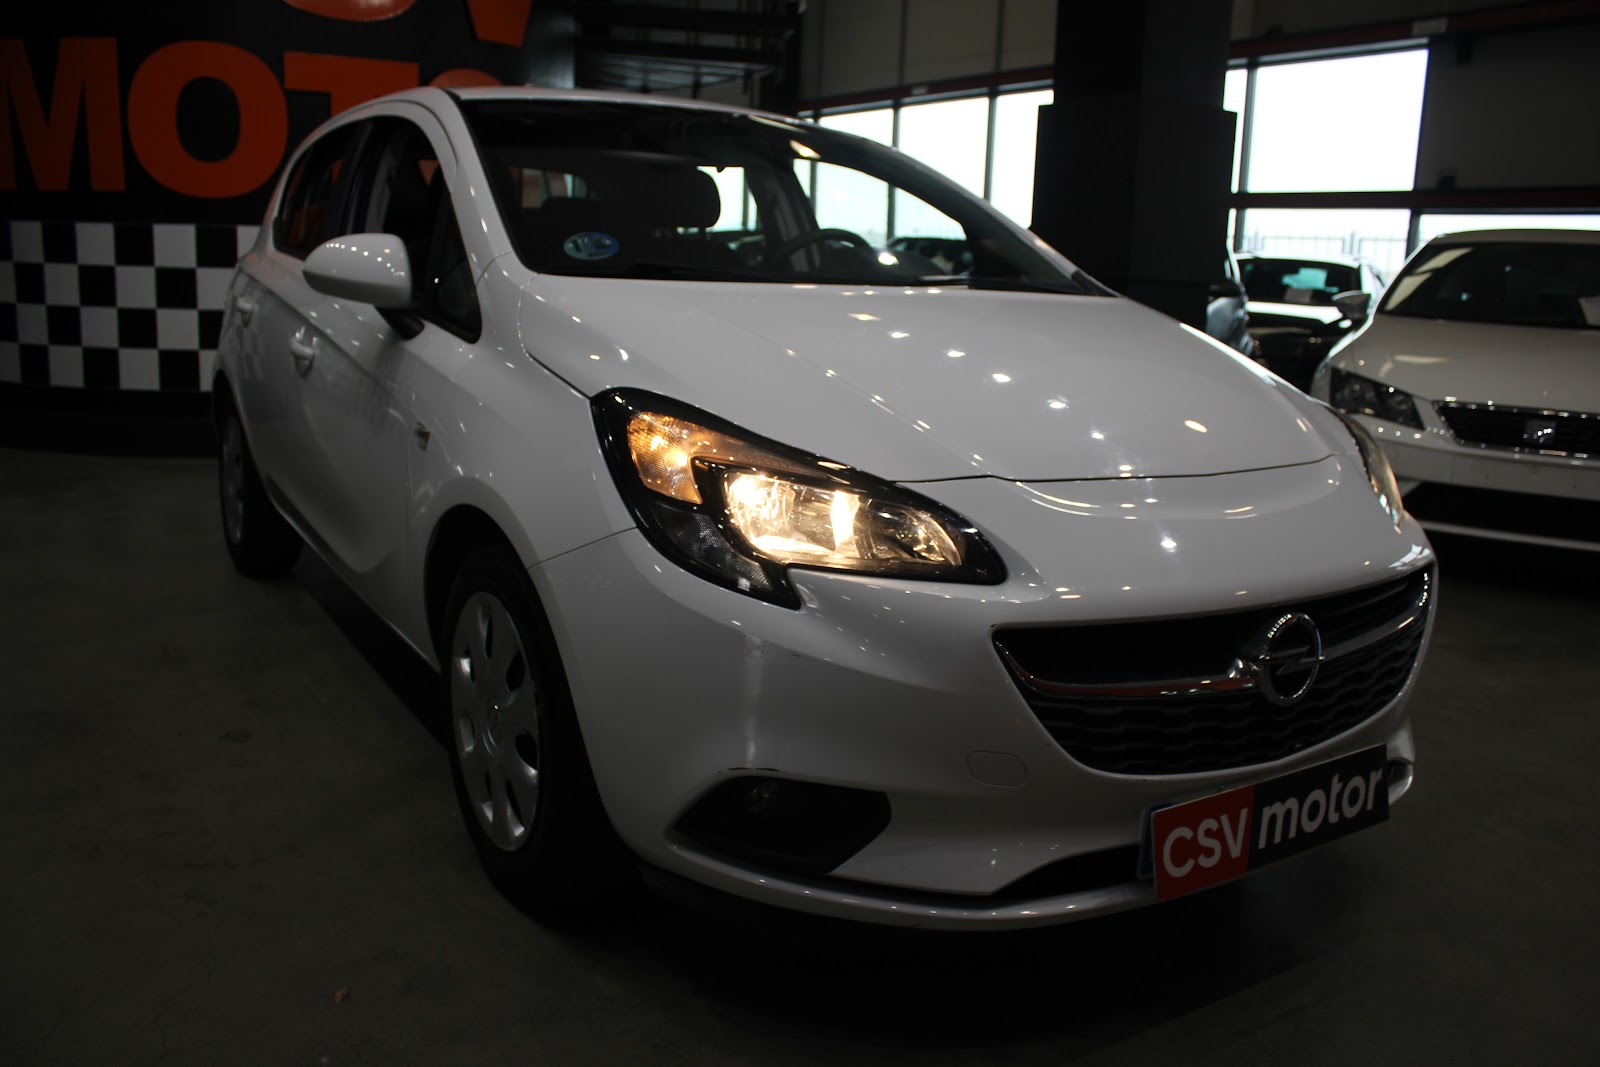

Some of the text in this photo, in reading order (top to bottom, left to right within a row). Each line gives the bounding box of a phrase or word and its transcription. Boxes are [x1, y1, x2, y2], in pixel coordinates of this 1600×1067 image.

[0, 36, 502, 199] MOT
[1163, 768, 1383, 878] CSV motor
